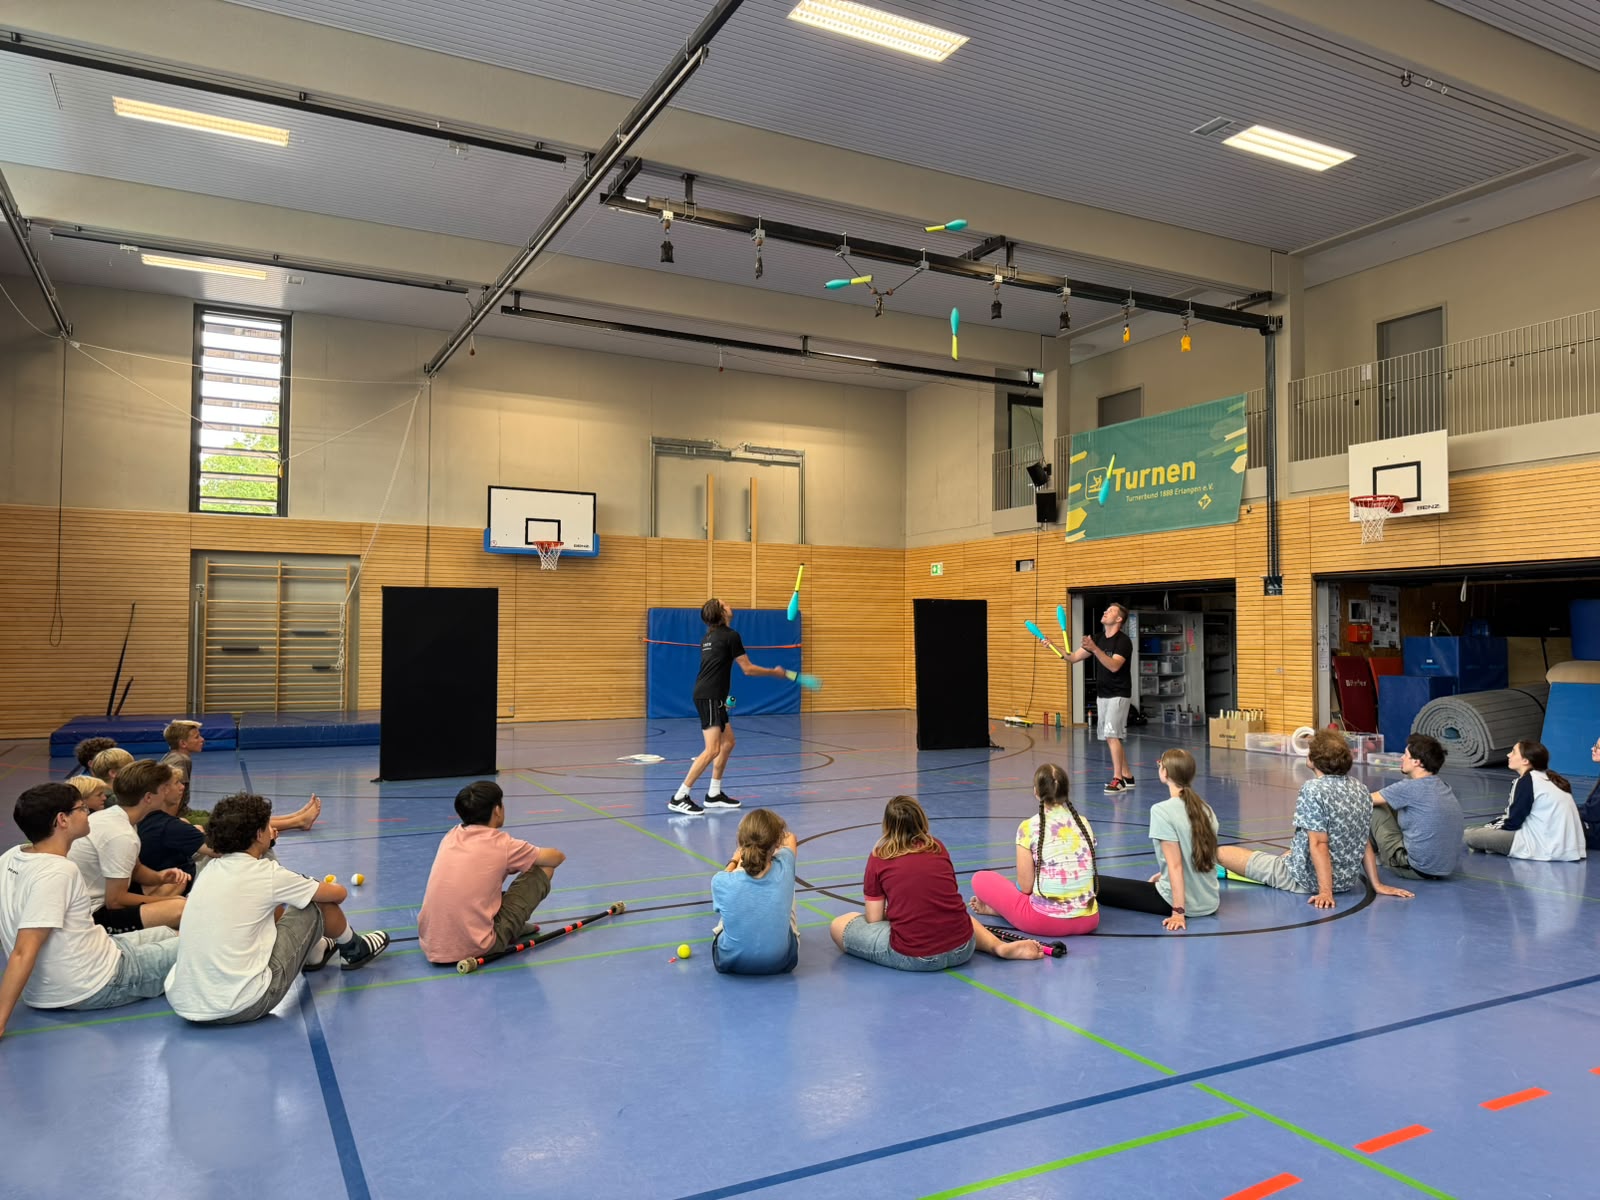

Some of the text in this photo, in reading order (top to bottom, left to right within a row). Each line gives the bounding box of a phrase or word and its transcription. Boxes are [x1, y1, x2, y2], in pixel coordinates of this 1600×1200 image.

[1112, 460, 1196, 492] Turnen
[1126, 492, 1159, 503] Turnerbund
[1175, 485, 1202, 496] Erlangen
